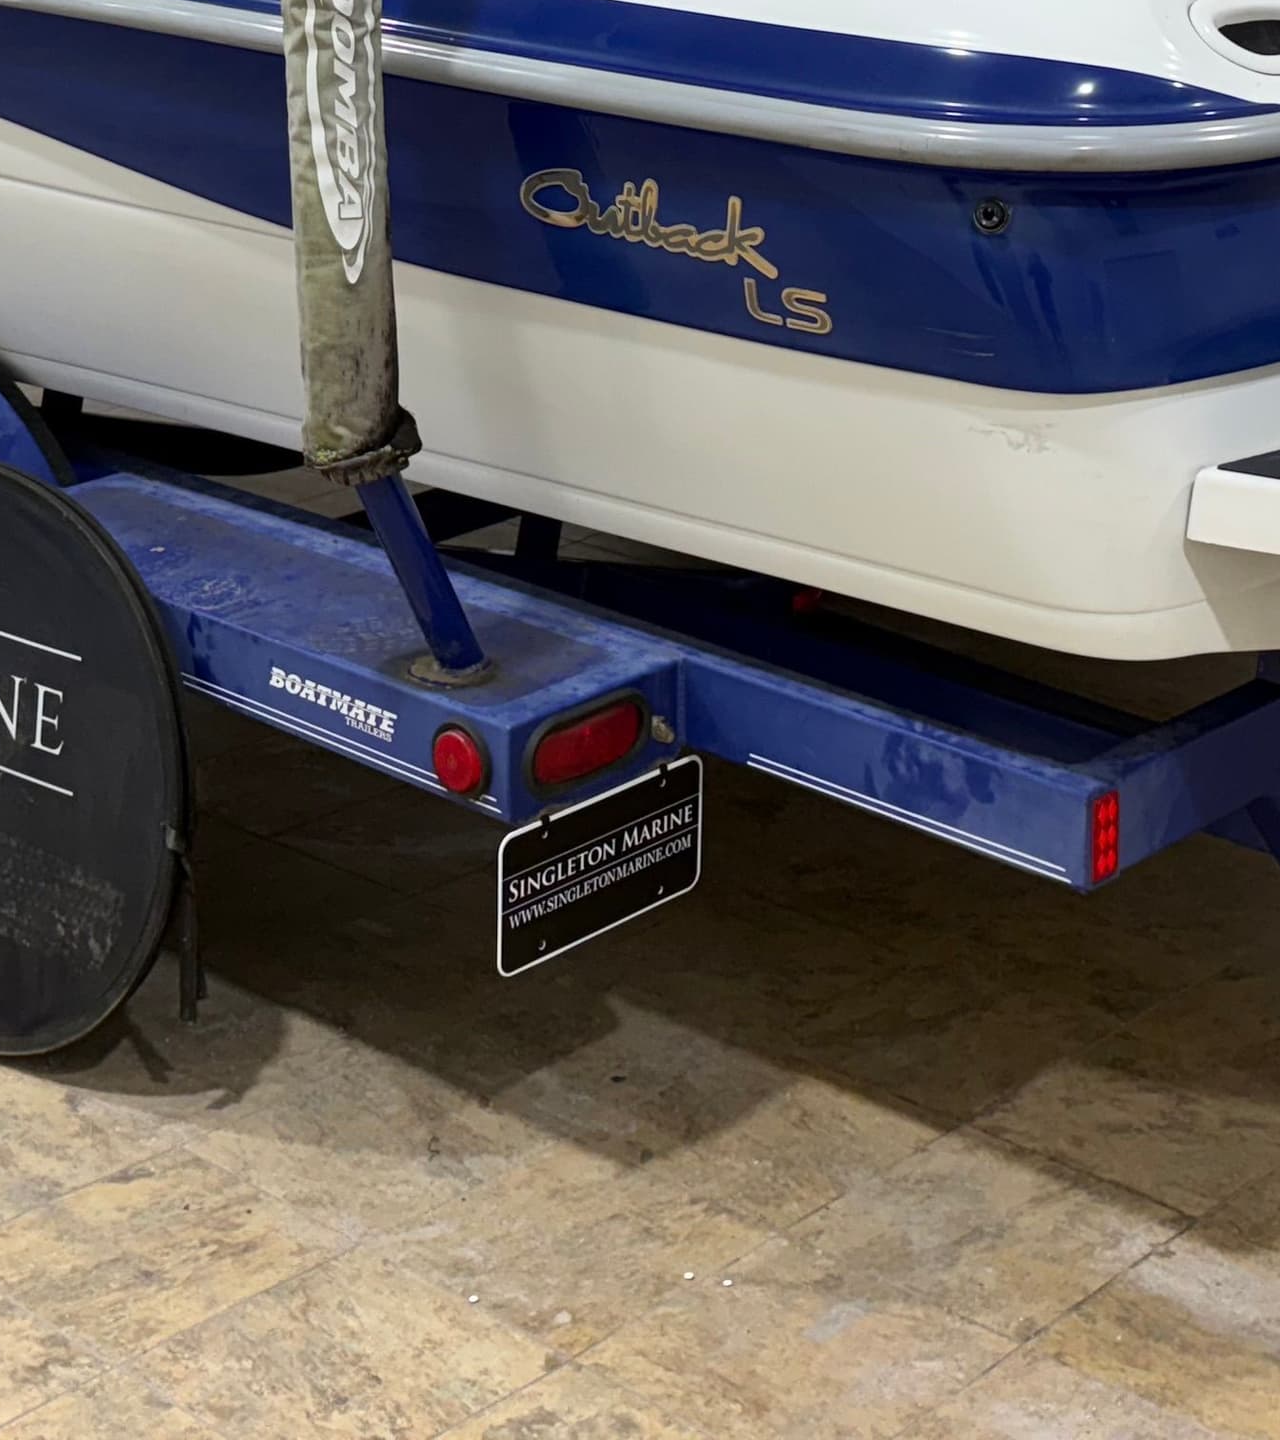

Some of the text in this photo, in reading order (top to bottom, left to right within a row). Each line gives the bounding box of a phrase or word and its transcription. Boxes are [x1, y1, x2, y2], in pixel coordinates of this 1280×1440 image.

[520, 168, 779, 279] Outback
[743, 277, 833, 334] LS
[269, 666, 398, 734] BOATMATE
[344, 716, 392, 743] TRAILERS
[508, 804, 694, 903] SINGLETON MARINE
[508, 833, 693, 930] WWW.SINGLETONMARINE.COM
